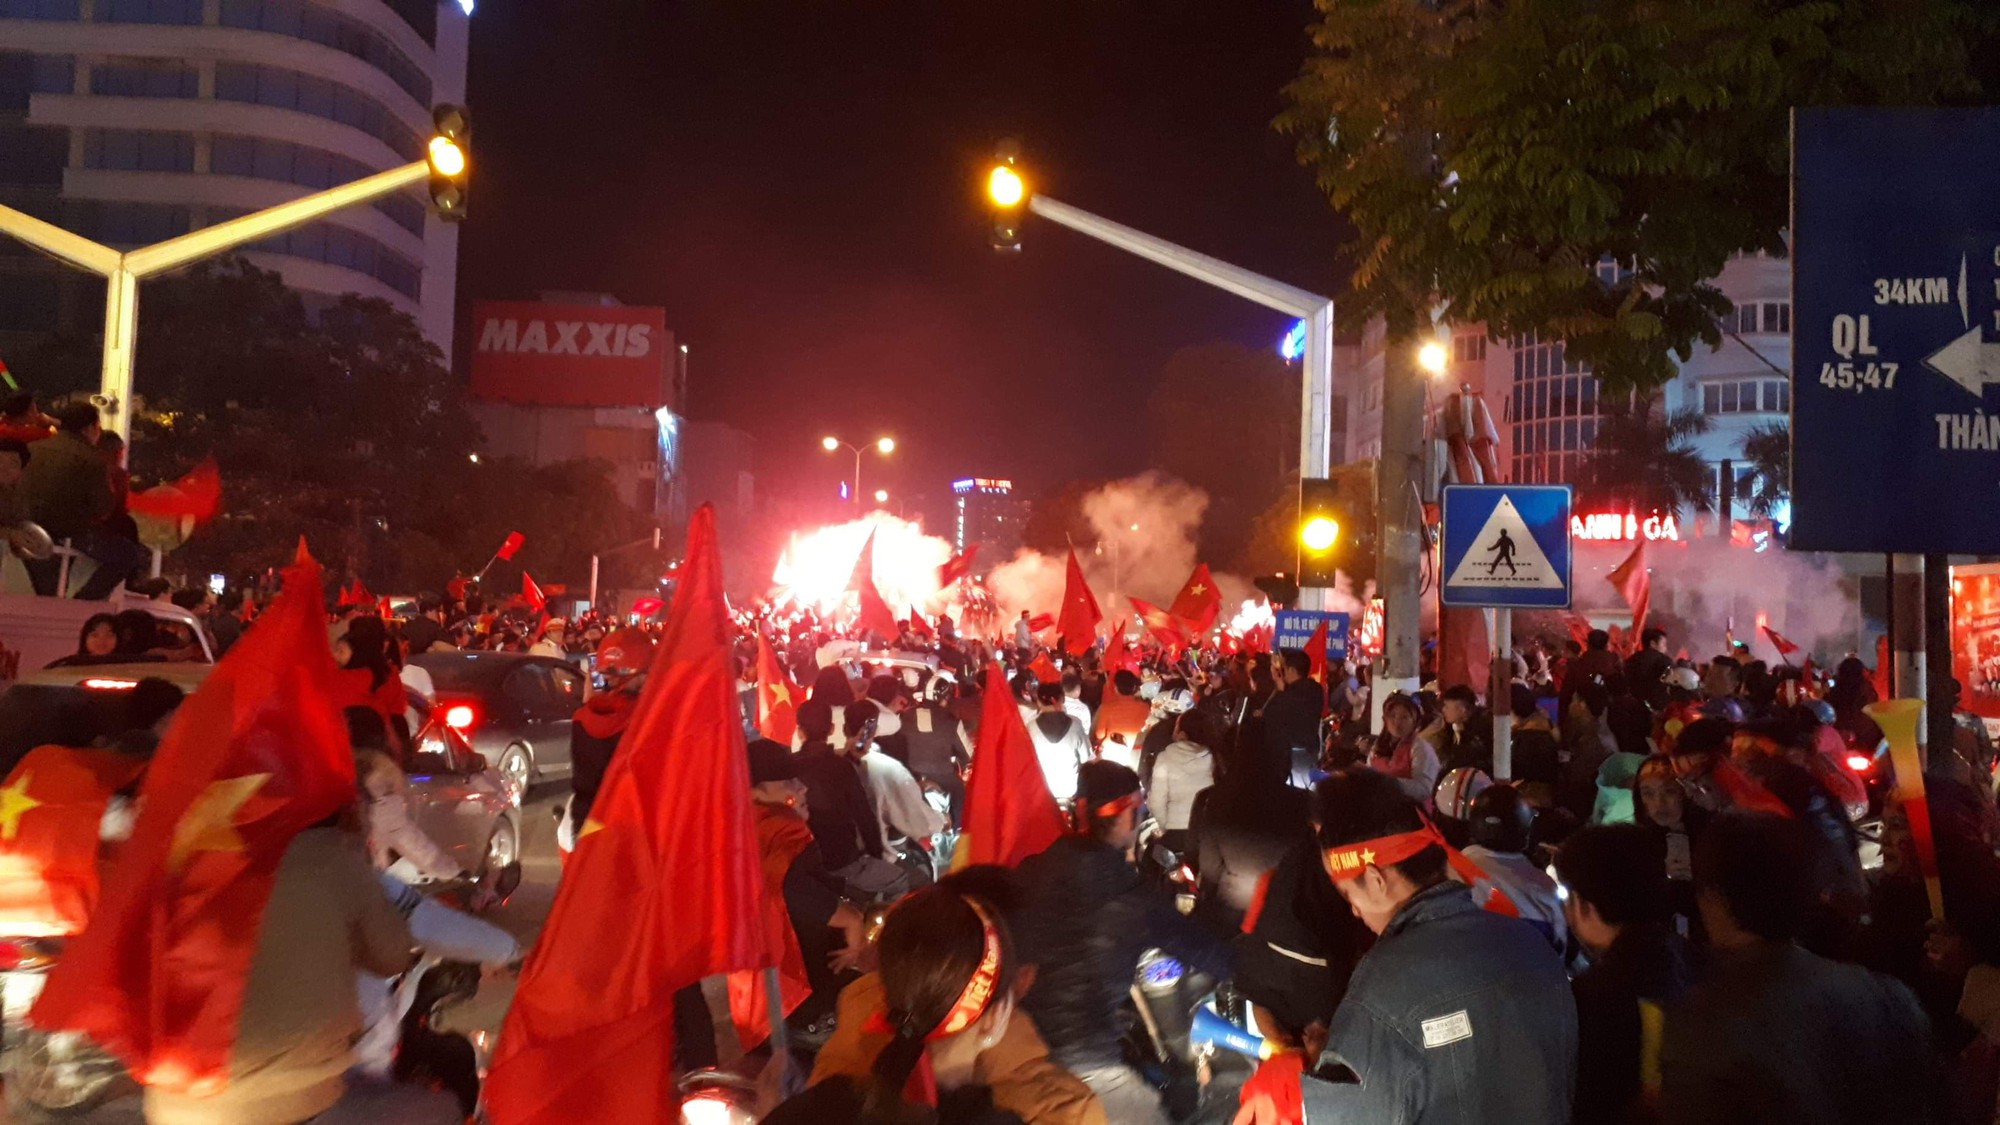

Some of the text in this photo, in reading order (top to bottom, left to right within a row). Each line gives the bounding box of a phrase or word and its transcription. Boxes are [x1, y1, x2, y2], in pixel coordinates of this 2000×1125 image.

[1874, 277, 1949, 304] 34KM
[479, 318, 651, 358] MAXXIS
[1832, 314, 1878, 359] QL
[1820, 362, 1899, 394] 45;47
[1340, 850, 1360, 870] NAM
